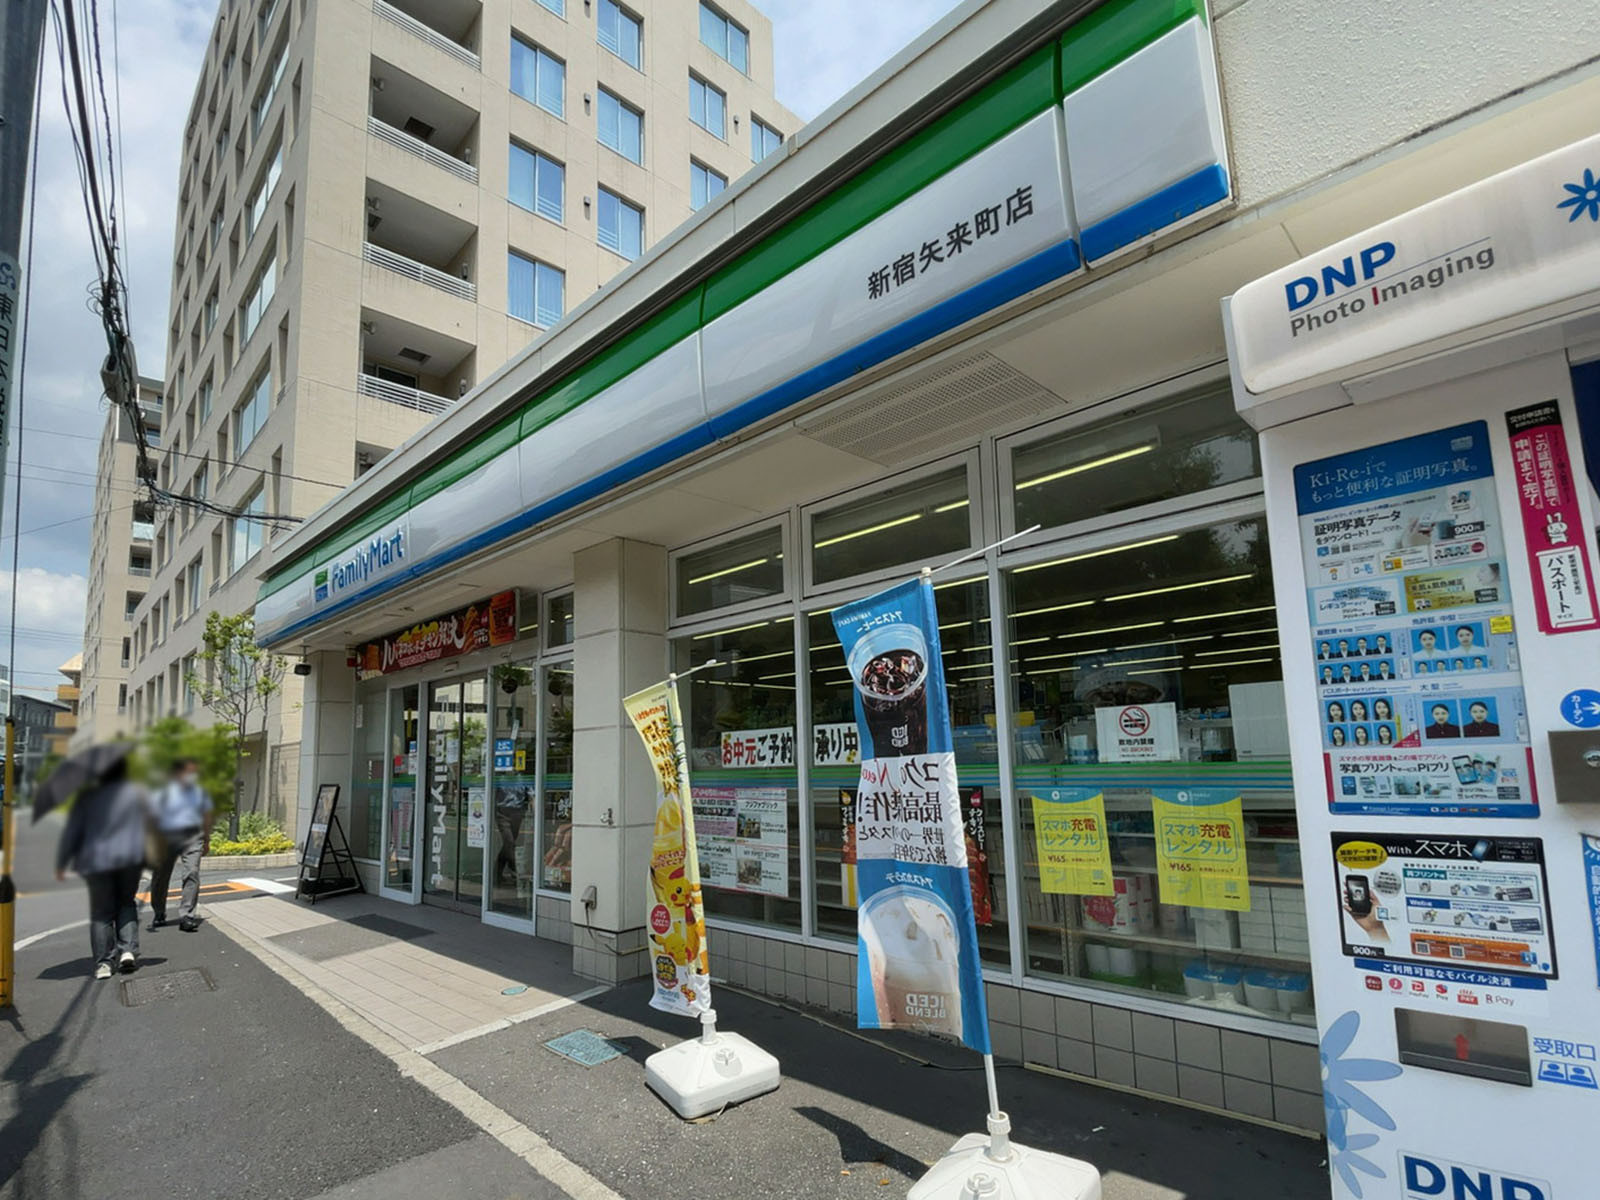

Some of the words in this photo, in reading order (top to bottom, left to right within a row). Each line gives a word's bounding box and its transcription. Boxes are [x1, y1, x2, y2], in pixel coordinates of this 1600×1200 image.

[867, 185, 1034, 300] 新宿矢来町店
[1285, 241, 1396, 312] DNP
[1290, 298, 1365, 337] Photo
[1372, 246, 1495, 306] Imaging
[1311, 457, 1478, 504] もっと便利な証明写真。
[1314, 510, 1401, 537] 証明写真データ
[332, 527, 404, 593] FamilyMart
[1548, 555, 1571, 614] パスポート
[722, 731, 793, 767] お中元ご予約
[815, 726, 859, 763] 承り中
[431, 693, 449, 886] FamilyMart
[1042, 817, 1097, 832] スマホ充電
[1164, 823, 1232, 839] スマホ充電
[1044, 832, 1097, 847] レンタル
[1166, 838, 1233, 855] レンタル
[1386, 845, 1412, 854] With
[1414, 839, 1474, 857] スマホ
[1169, 862, 1192, 872] ¥165
[1382, 963, 1512, 988] ご利用可能なモバイル決済
[1495, 996, 1514, 1006] Pay
[1533, 1036, 1598, 1062] 受取口
[1402, 1155, 1545, 1200] DNP
